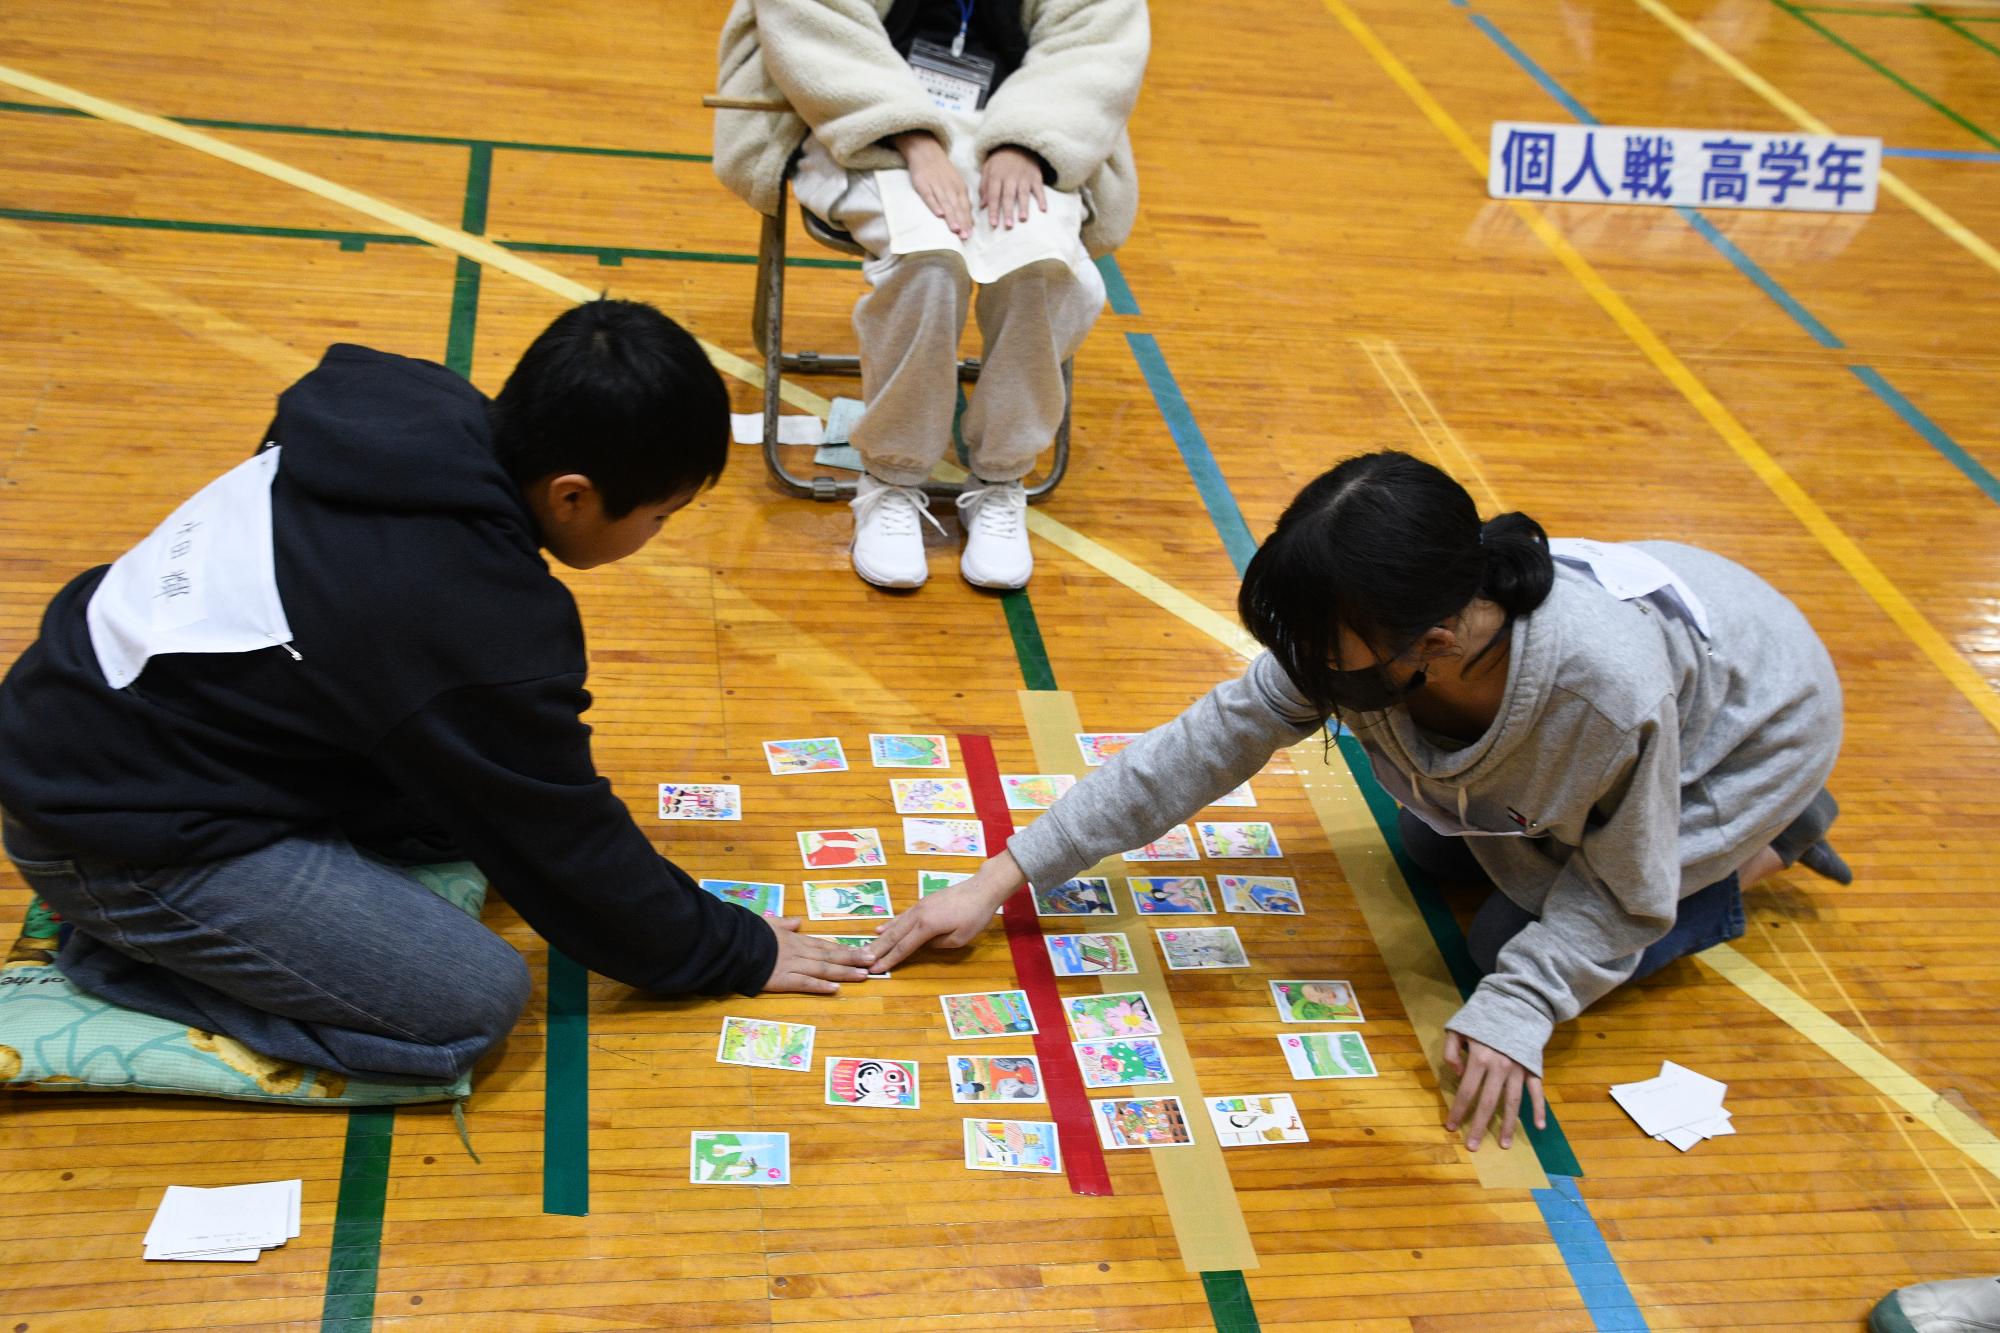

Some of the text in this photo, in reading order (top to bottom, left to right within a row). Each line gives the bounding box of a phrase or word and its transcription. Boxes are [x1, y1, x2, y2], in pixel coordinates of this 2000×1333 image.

[1502, 129, 1866, 206] 個人戦 高学年
